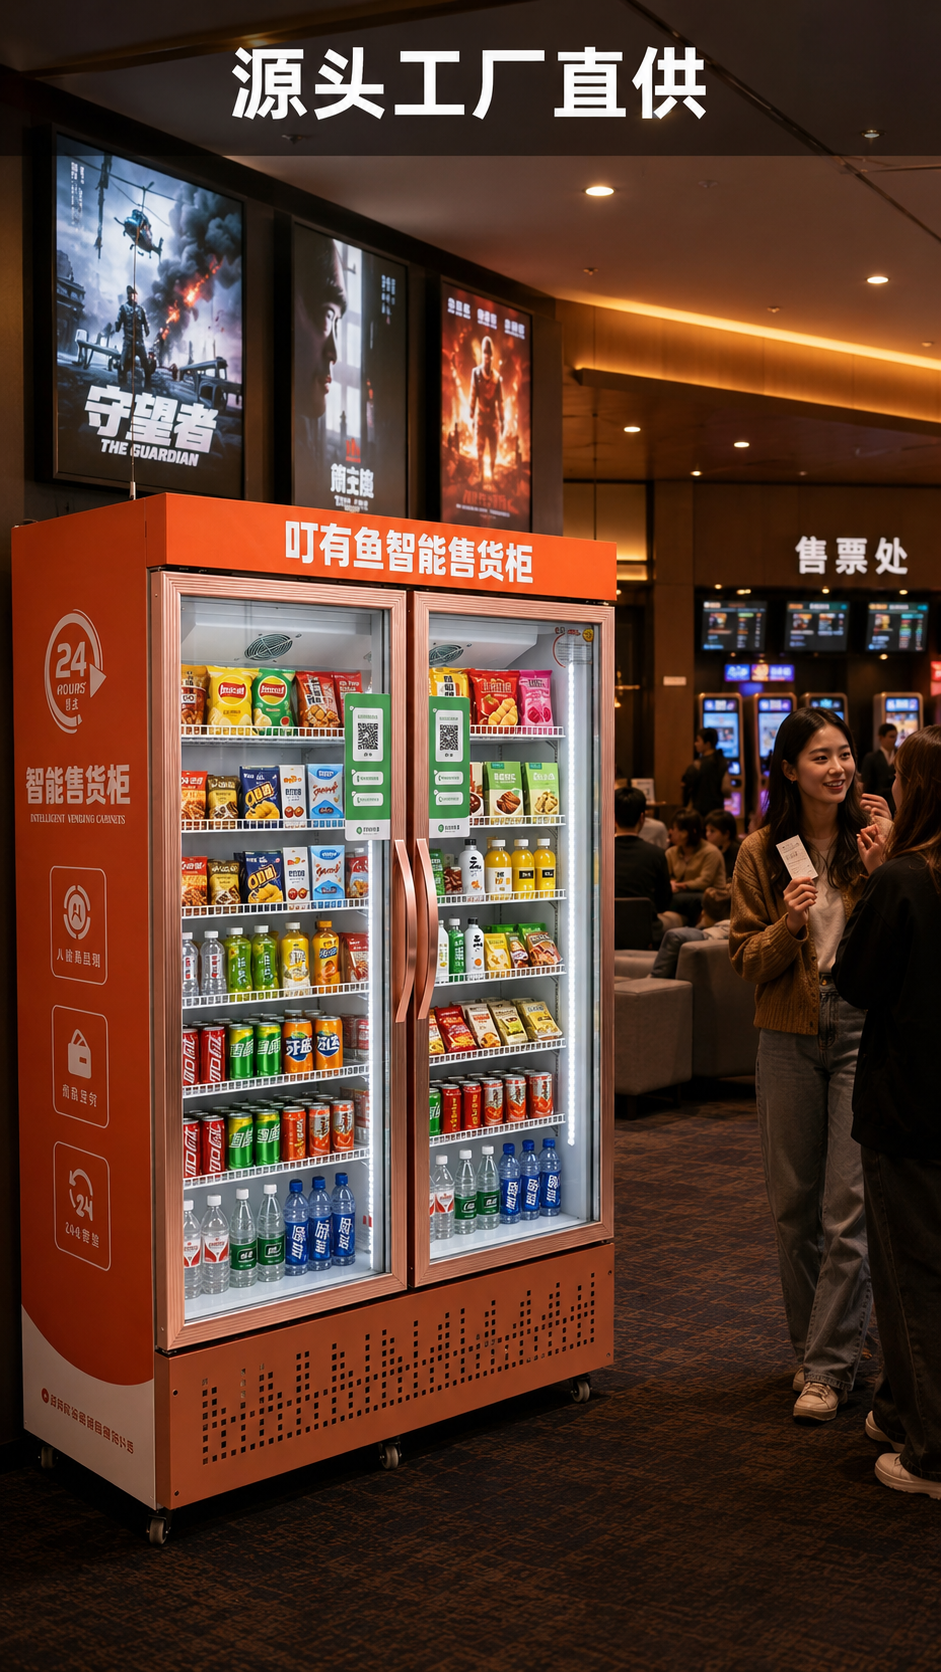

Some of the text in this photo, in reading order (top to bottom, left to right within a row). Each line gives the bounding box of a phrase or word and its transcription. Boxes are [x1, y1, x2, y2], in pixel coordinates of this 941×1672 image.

[84, 385, 219, 453] 守望者
[101, 439, 199, 467] THE GUARDIAN
[285, 520, 534, 584] 叮有鱼智能售货柜
[795, 536, 908, 575] 售票处
[55, 641, 87, 678] 24
[26, 764, 131, 805] 智能售货柜
